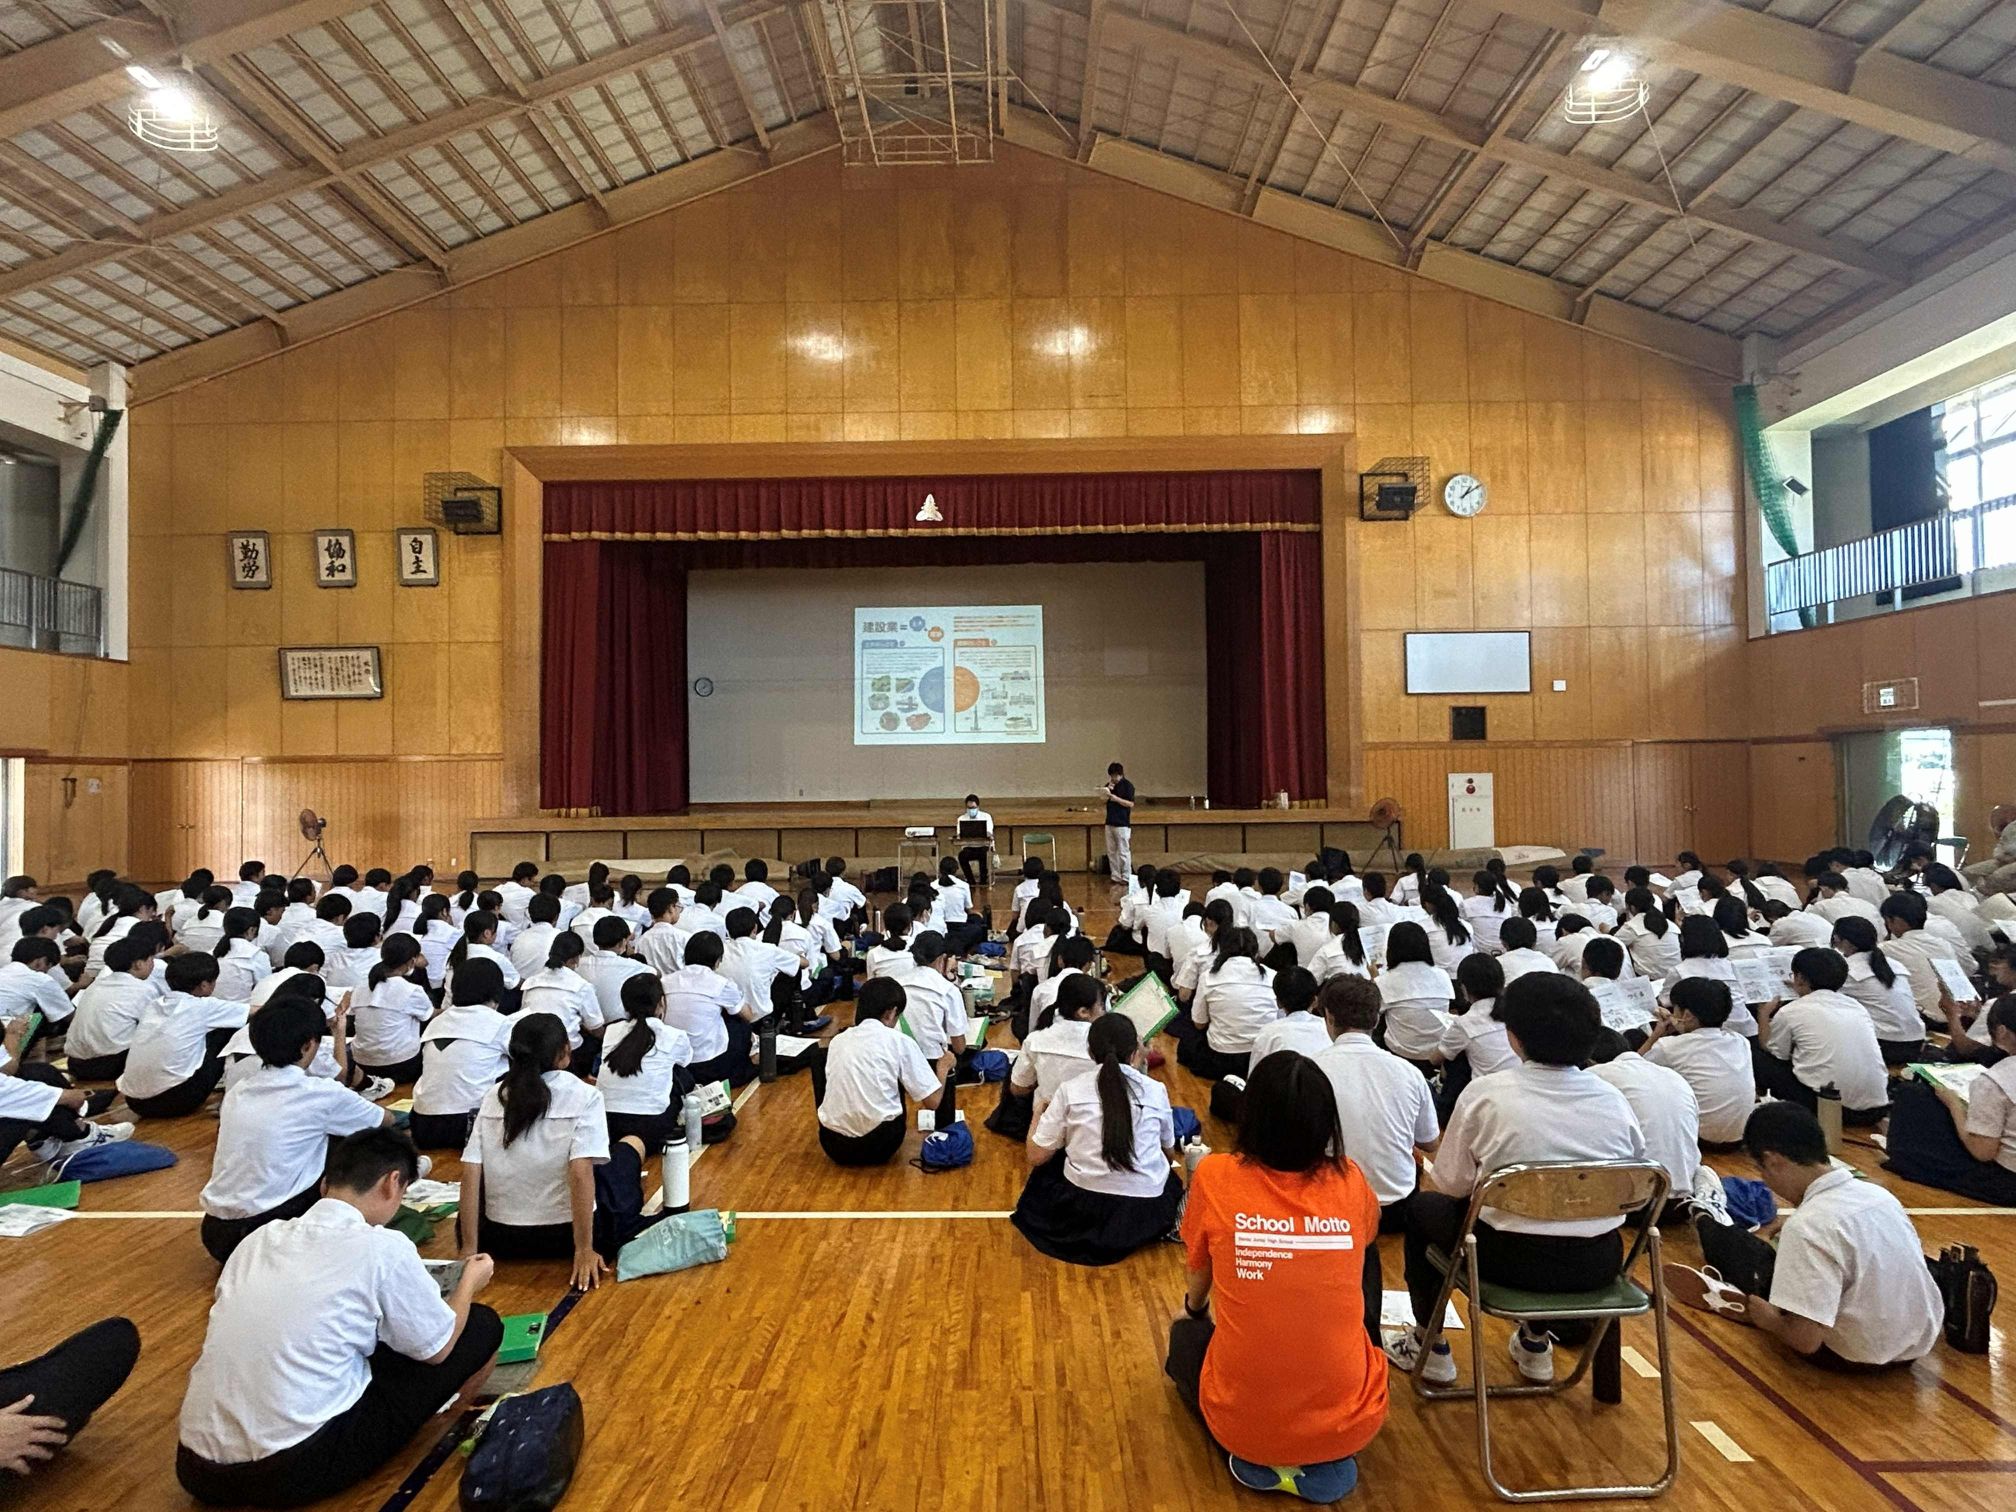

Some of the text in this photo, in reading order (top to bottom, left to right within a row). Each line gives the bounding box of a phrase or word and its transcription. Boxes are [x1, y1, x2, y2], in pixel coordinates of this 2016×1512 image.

[239, 539, 259, 579] 勤労
[325, 538, 346, 578] 協和
[409, 537, 427, 575] 自主
[1235, 1212, 1351, 1233] School Motto
[1235, 1247, 1293, 1259] Independence
[1236, 1257, 1273, 1270] Harmony
[1236, 1267, 1264, 1280] Work
